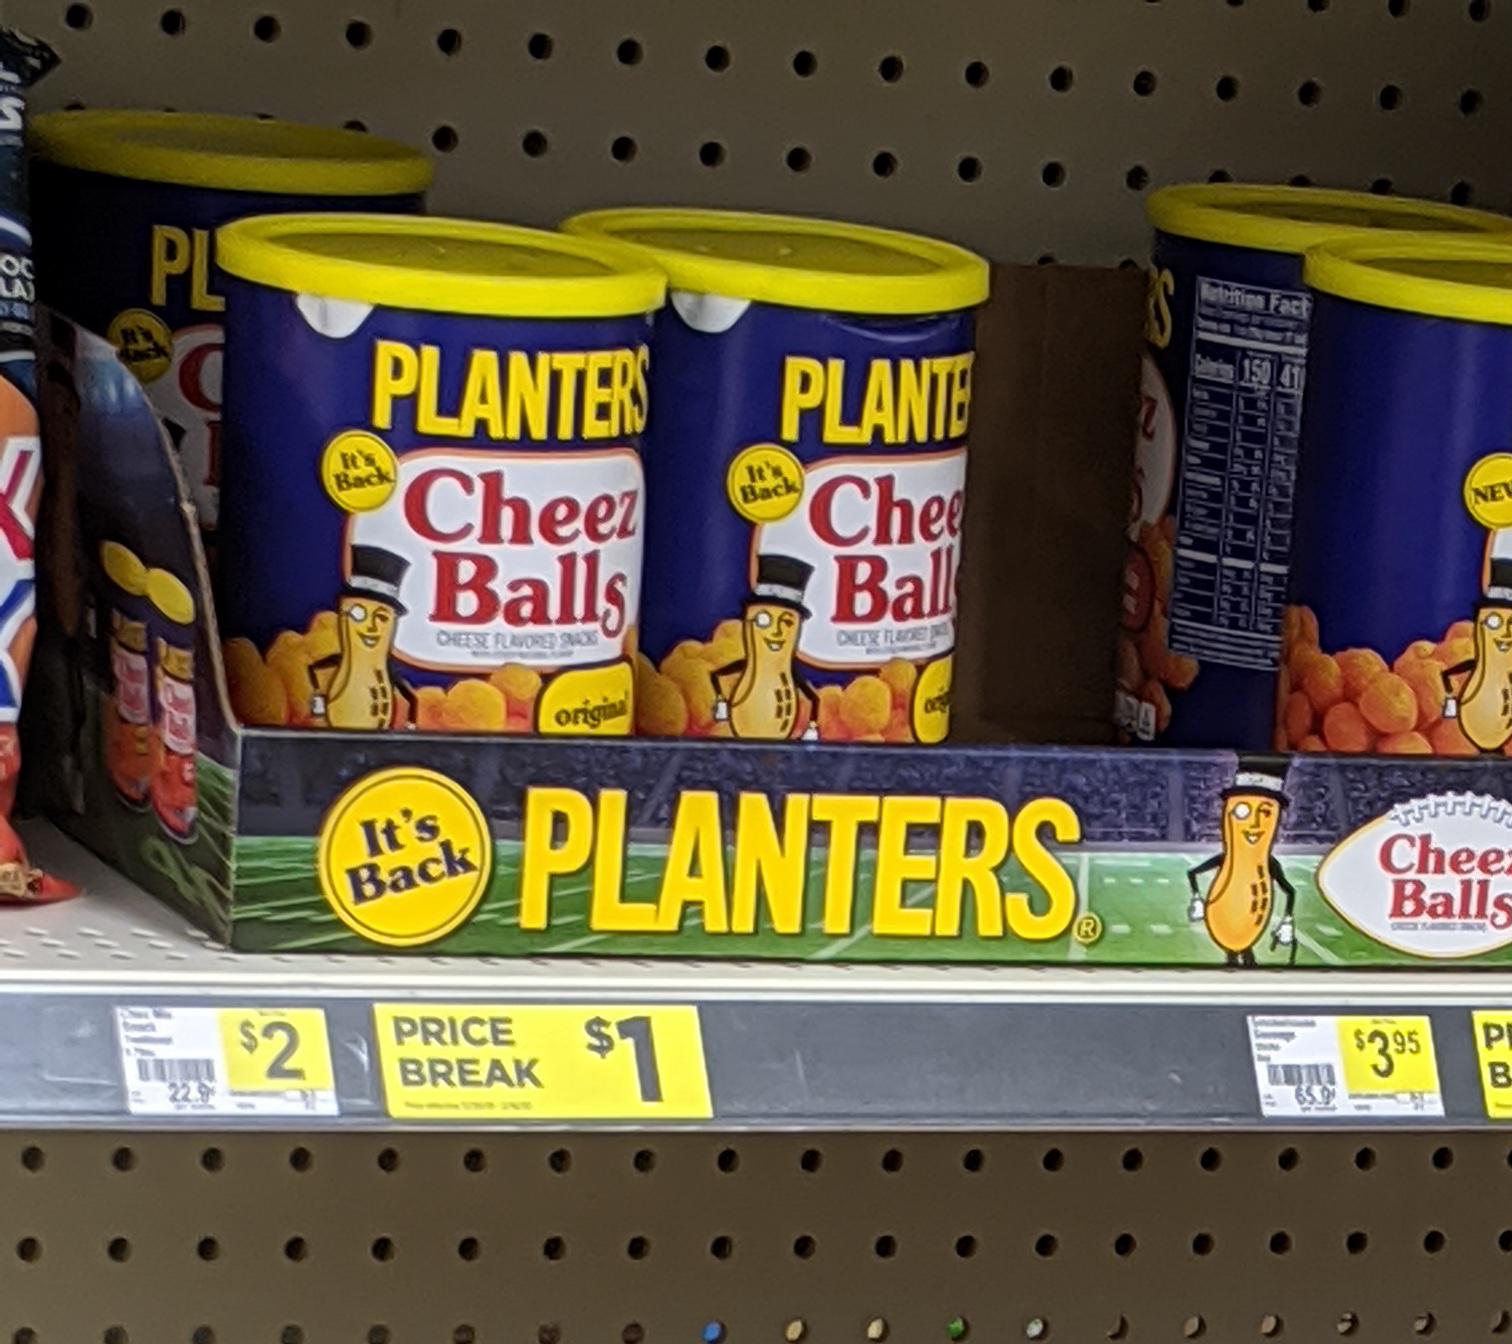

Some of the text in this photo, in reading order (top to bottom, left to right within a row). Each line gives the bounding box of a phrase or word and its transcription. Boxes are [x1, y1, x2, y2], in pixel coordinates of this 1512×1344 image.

[371, 339, 649, 441] PLANTERS
[780, 351, 975, 444] PLANTE
[333, 466, 397, 491] Back
[340, 450, 376, 470] It's
[741, 480, 800, 504] Back
[747, 462, 782, 483] It's
[403, 468, 640, 547] Cheez
[809, 474, 963, 548] Chee
[429, 549, 627, 638] Balls
[830, 546, 953, 624] Ball
[437, 630, 490, 648] CHEESE
[361, 808, 442, 859] It's
[519, 785, 1084, 939] PLANTERS
[345, 841, 479, 906] Back
[238, 1019, 307, 1083] $2
[392, 1015, 517, 1047] PRICE
[584, 1015, 667, 1104] $1
[399, 1058, 543, 1090] BREAK
